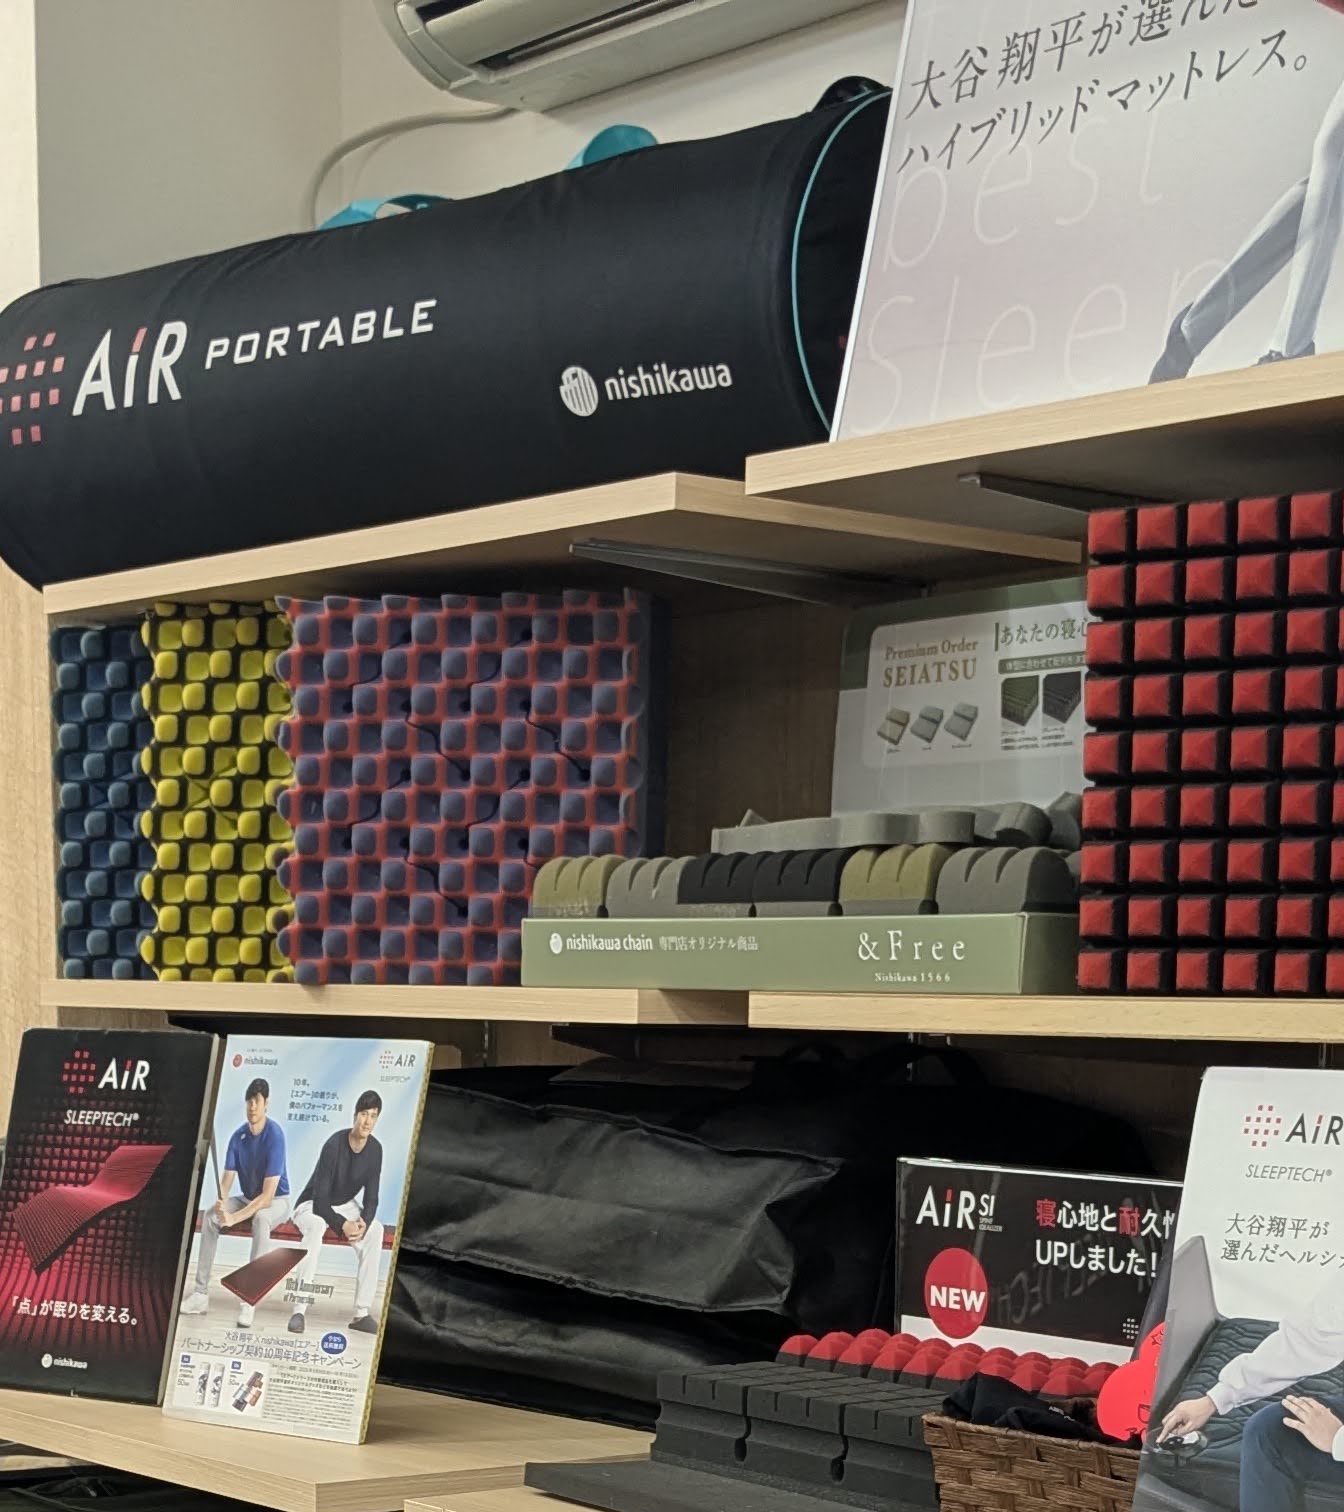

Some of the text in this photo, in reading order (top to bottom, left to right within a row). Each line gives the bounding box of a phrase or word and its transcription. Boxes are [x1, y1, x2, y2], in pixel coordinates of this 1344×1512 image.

[905, 0, 1255, 120] 大谷翔平が選ん
[897, 29, 1308, 174] ハイブリッドマットレス。
[205, 298, 437, 370] PORTABLE
[604, 360, 733, 402] nishikawa
[885, 637, 978, 661] Premium Order
[882, 658, 977, 688] SEIATSU
[566, 934, 620, 950] nishikawa
[623, 934, 653, 950] chain
[1225, 1213, 1330, 1239] 大谷翔平が
[11, 1295, 138, 1326] 「点」が眠りを変える。
[929, 1285, 986, 1312] NEW
